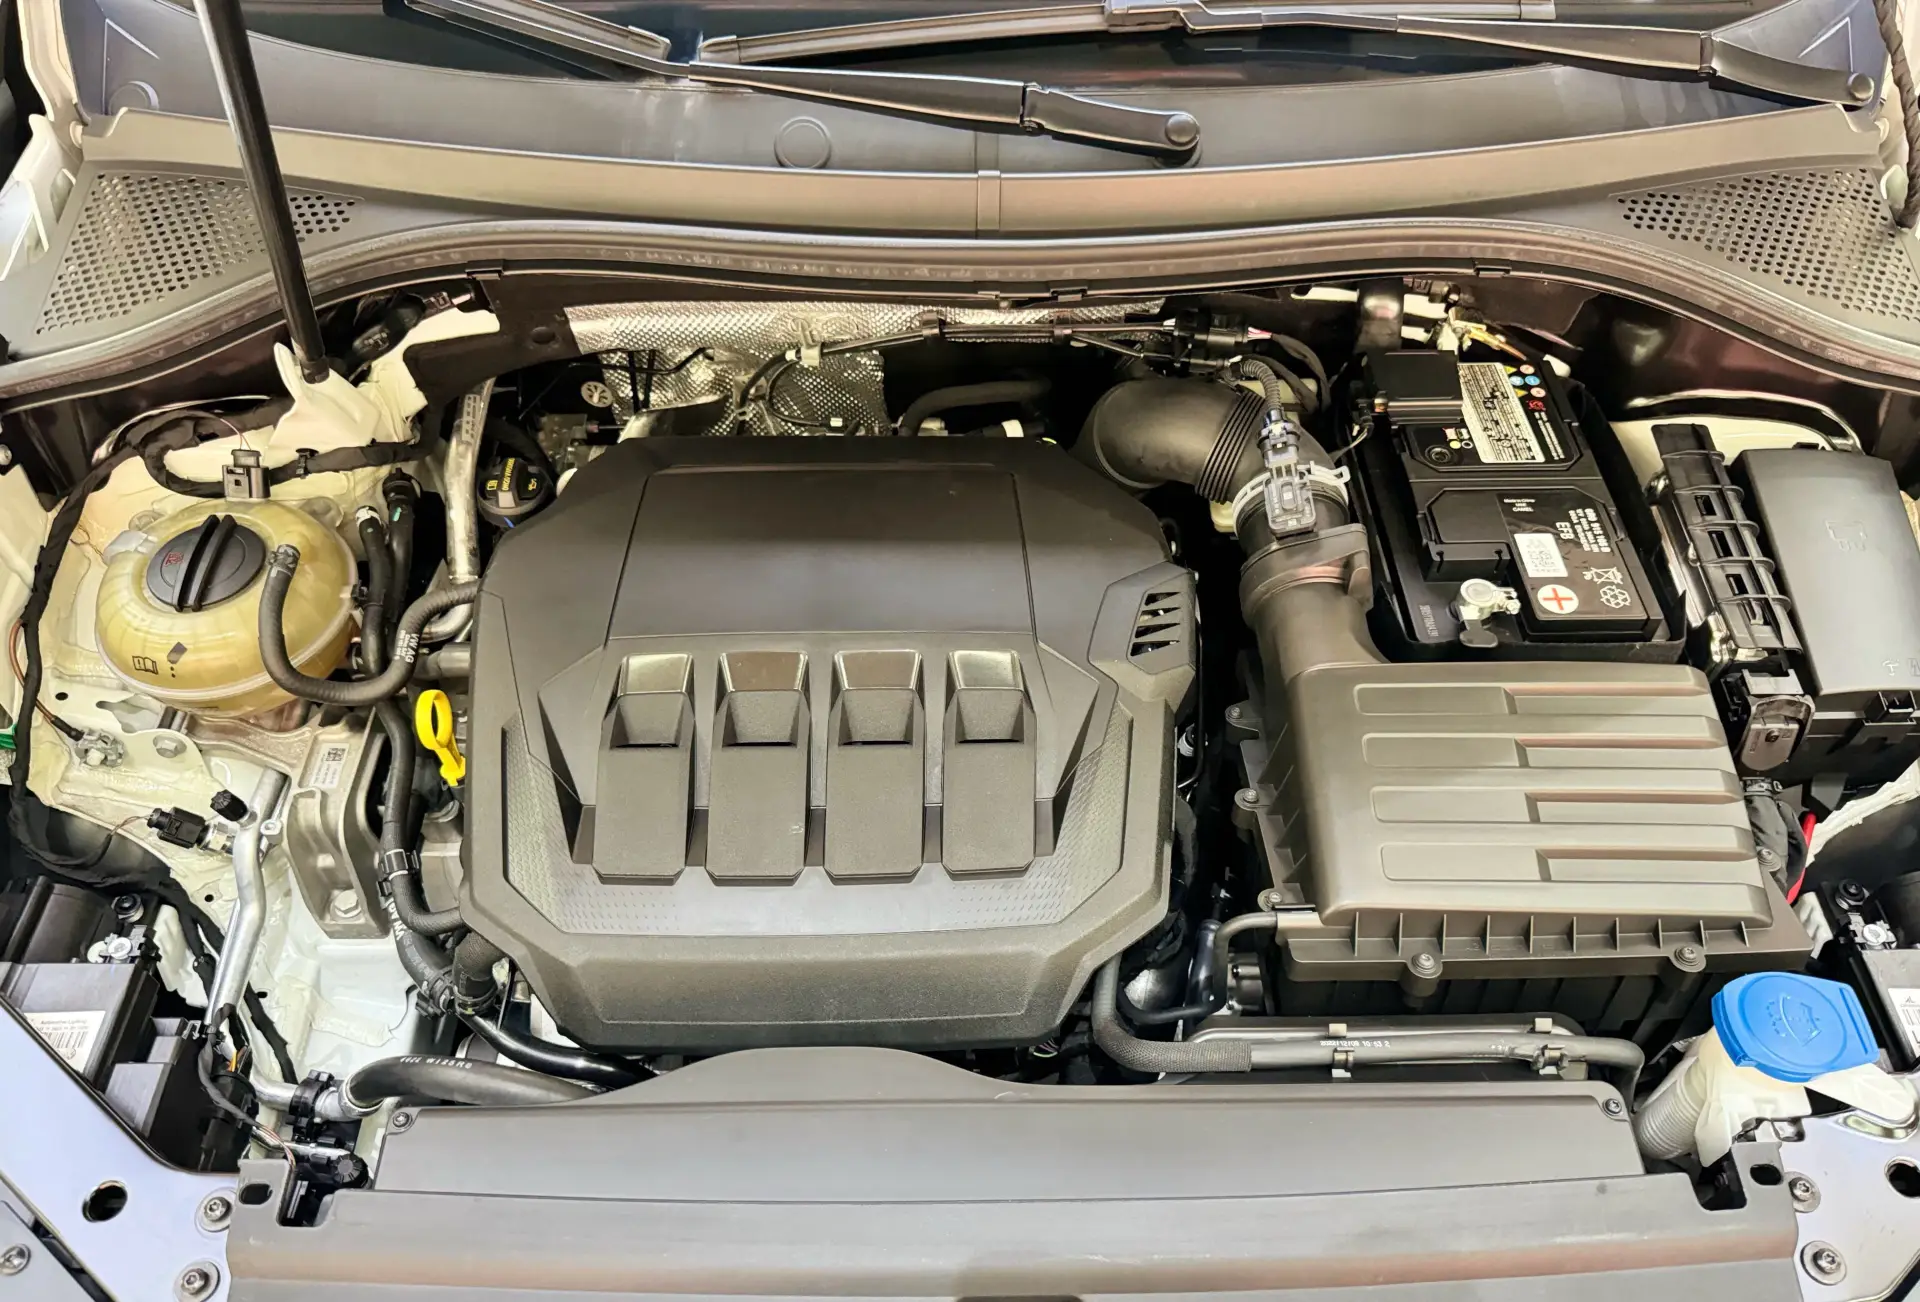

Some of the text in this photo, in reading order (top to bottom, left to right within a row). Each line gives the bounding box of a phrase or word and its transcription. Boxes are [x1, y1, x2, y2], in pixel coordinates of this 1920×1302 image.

[1555, 522, 1574, 539] EFB
[409, 633, 420, 649] VW
[405, 647, 416, 663] AG
